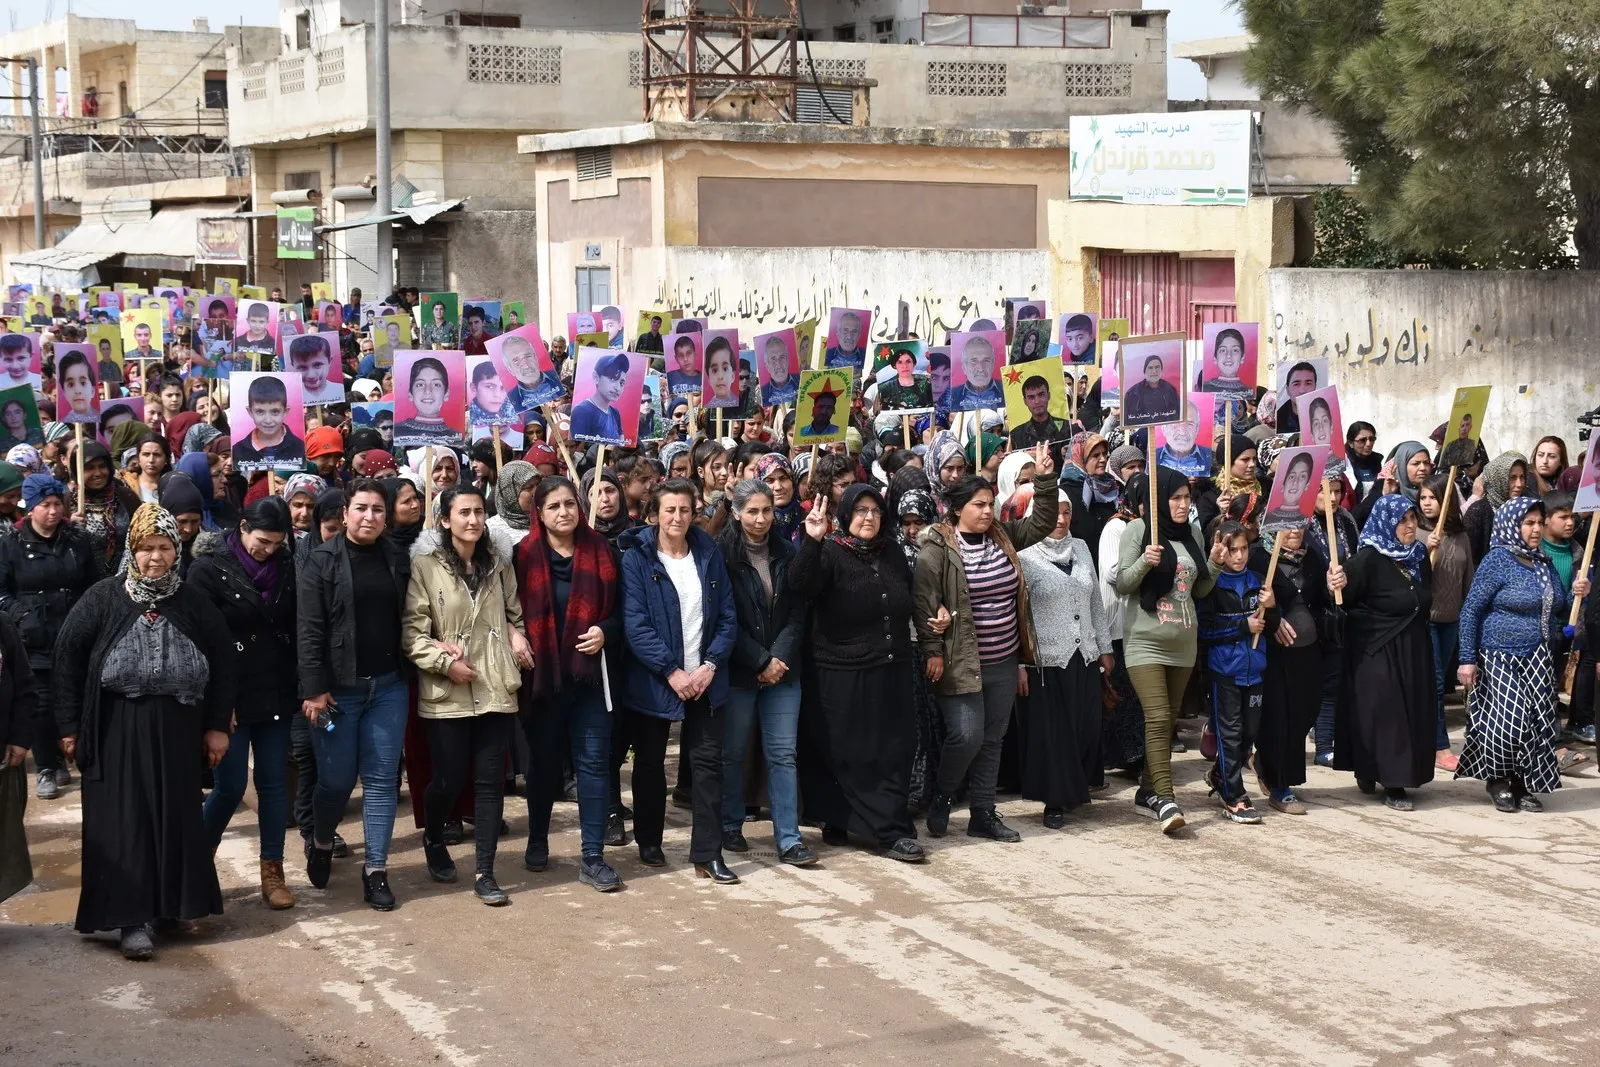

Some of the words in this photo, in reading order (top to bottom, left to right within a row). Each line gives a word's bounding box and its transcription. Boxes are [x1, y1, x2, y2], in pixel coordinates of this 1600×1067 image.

[1115, 121, 1148, 138] الشهيد
[1151, 121, 1190, 138] مدرسة
[1092, 145, 1149, 176] قرندل
[1153, 150, 1216, 171] محمد
[1137, 412, 1150, 420] شعبان
[1151, 411, 1159, 419] علي
